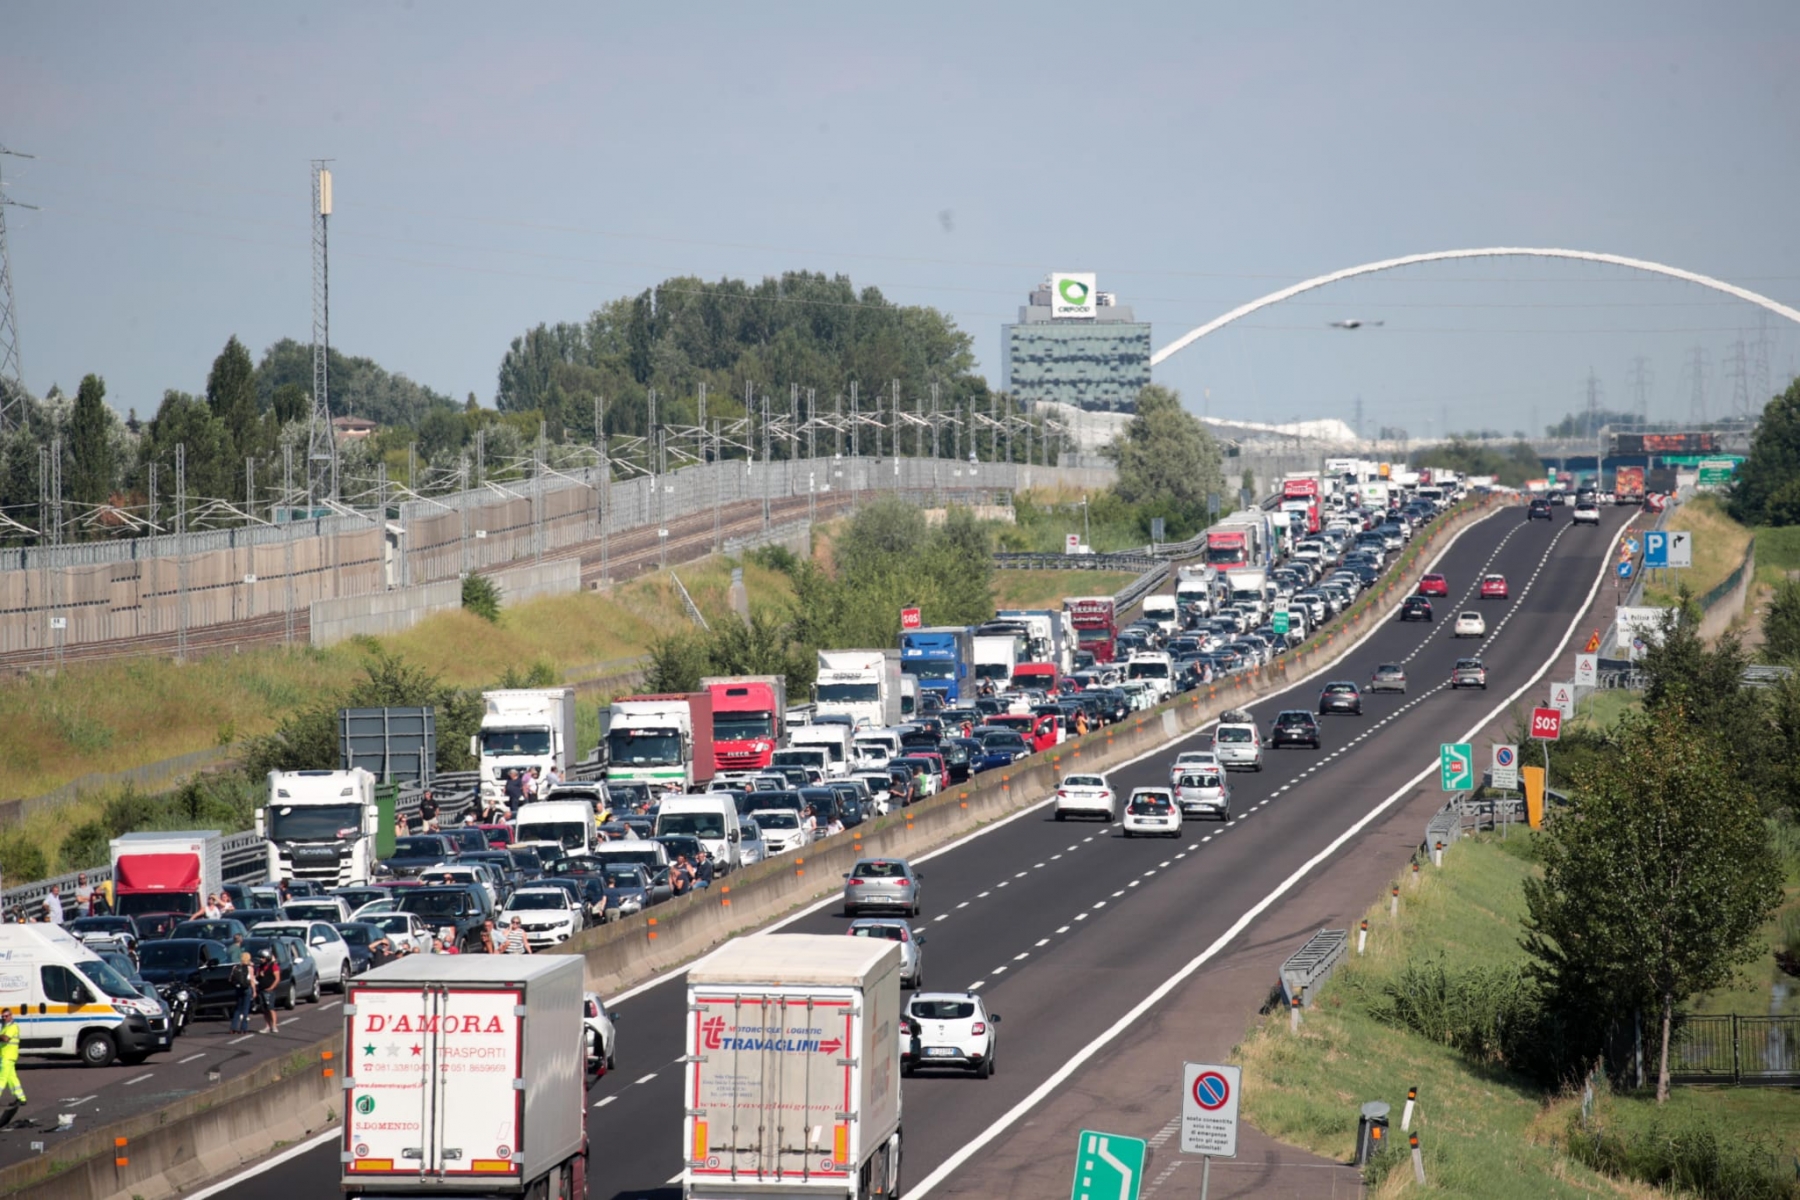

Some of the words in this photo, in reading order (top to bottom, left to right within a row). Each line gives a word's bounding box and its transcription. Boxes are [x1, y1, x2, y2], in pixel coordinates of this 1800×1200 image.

[1648, 534, 1663, 554] P
[903, 613, 918, 624] SOS
[1535, 716, 1557, 731] SOS
[365, 1014, 504, 1034] D'AMORA
[786, 1027, 822, 1035] LOGISTIC
[722, 1037, 819, 1053] TRAVAGLINI
[437, 1047, 506, 1058] TRASPORTI
[356, 1122, 419, 1131] S.DOMENICO
